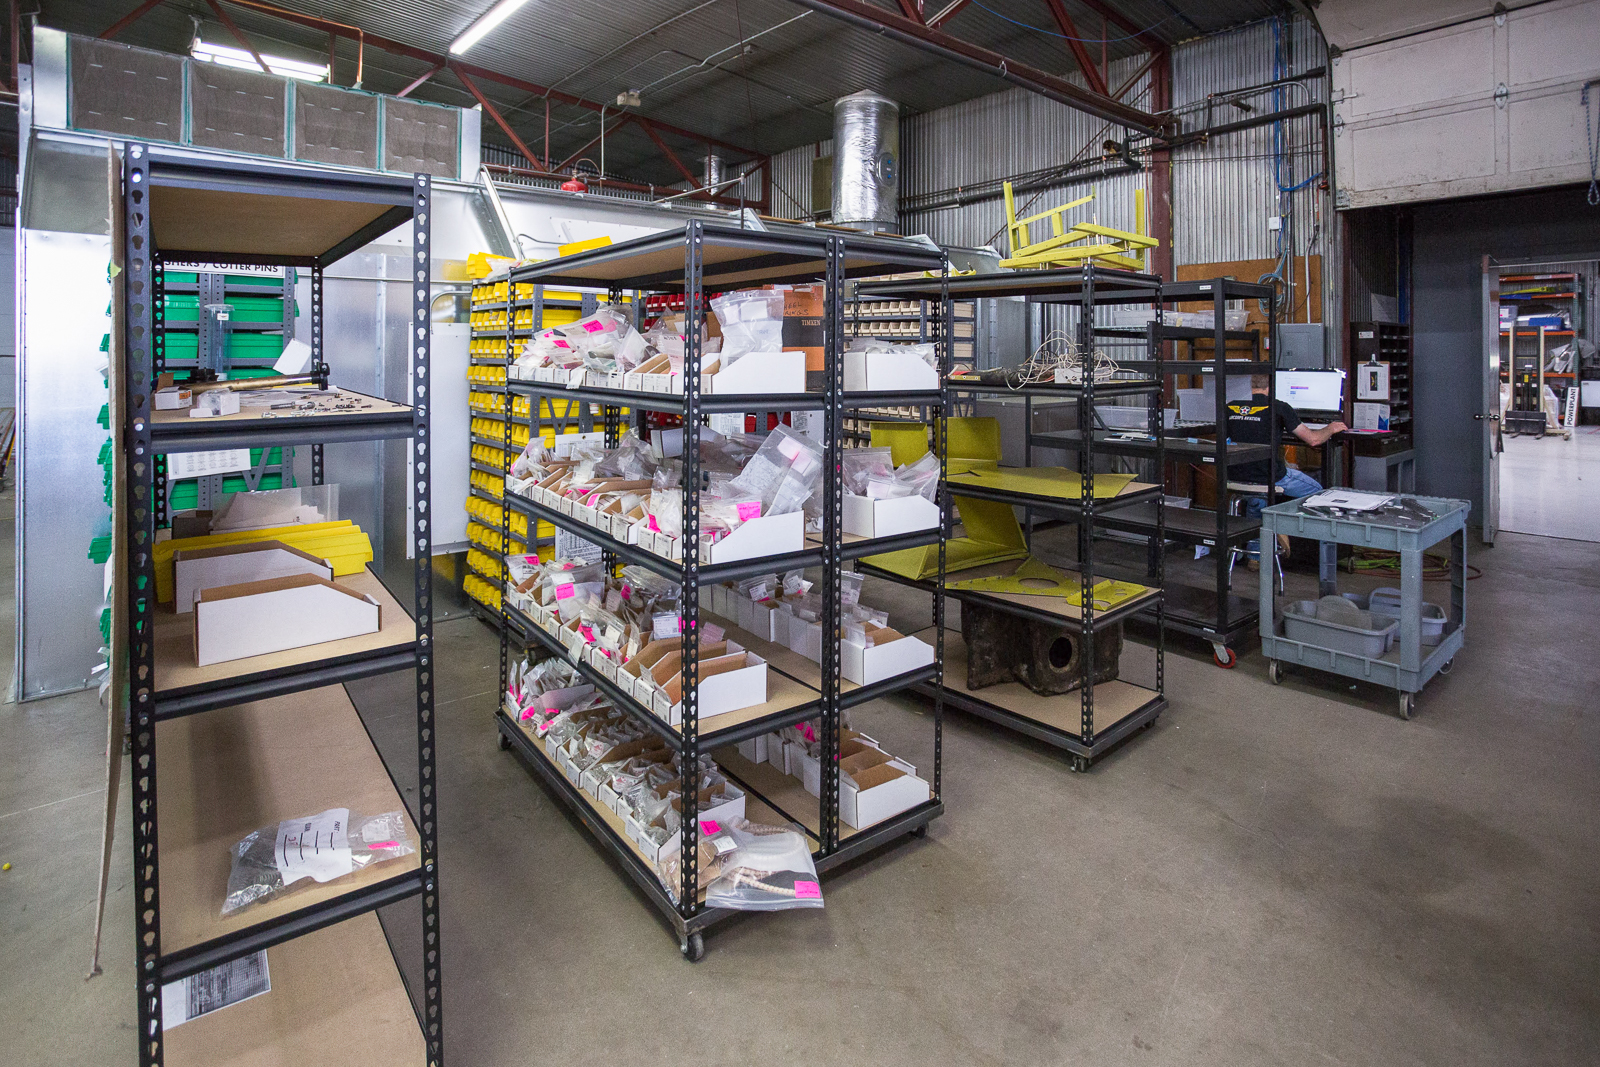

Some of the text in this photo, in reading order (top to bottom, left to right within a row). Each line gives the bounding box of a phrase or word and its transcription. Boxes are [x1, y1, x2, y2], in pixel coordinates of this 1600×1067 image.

[212, 262, 251, 271] COTTER
[254, 264, 279, 273] PINS
[1566, 388, 1577, 426] POWERPLANT
